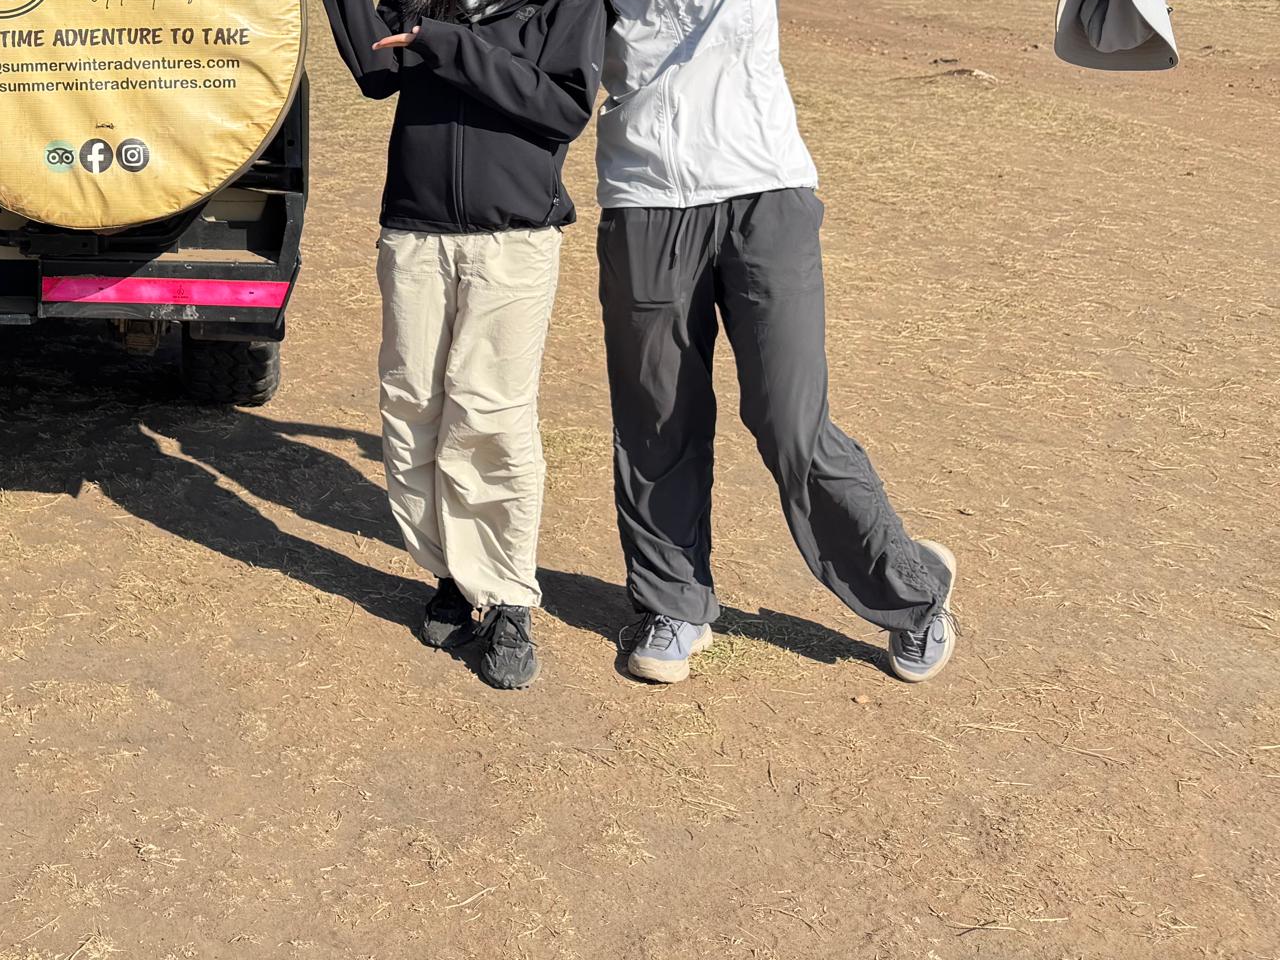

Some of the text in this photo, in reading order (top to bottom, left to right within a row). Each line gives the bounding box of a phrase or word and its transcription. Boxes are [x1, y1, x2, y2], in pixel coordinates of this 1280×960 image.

[0, 29, 46, 48] TIME
[52, 27, 164, 47] ADVENTURE
[170, 27, 195, 45] TO
[202, 26, 251, 46] TAKE
